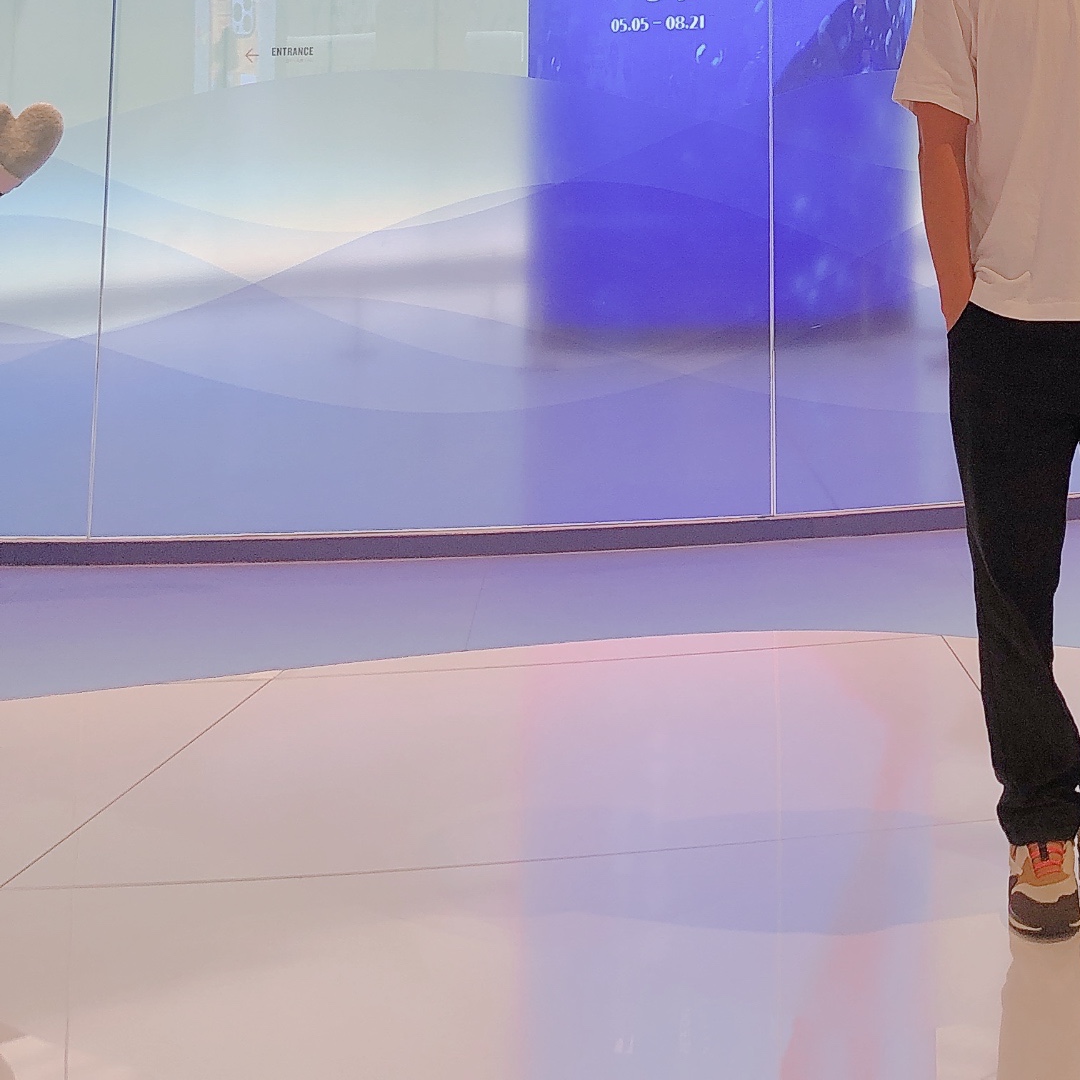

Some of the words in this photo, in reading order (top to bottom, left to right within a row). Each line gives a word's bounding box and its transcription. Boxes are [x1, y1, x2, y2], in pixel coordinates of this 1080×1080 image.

[610, 17, 650, 33] 05.05
[665, 14, 705, 31] 08.21
[271, 46, 314, 57] ENTRANCE
